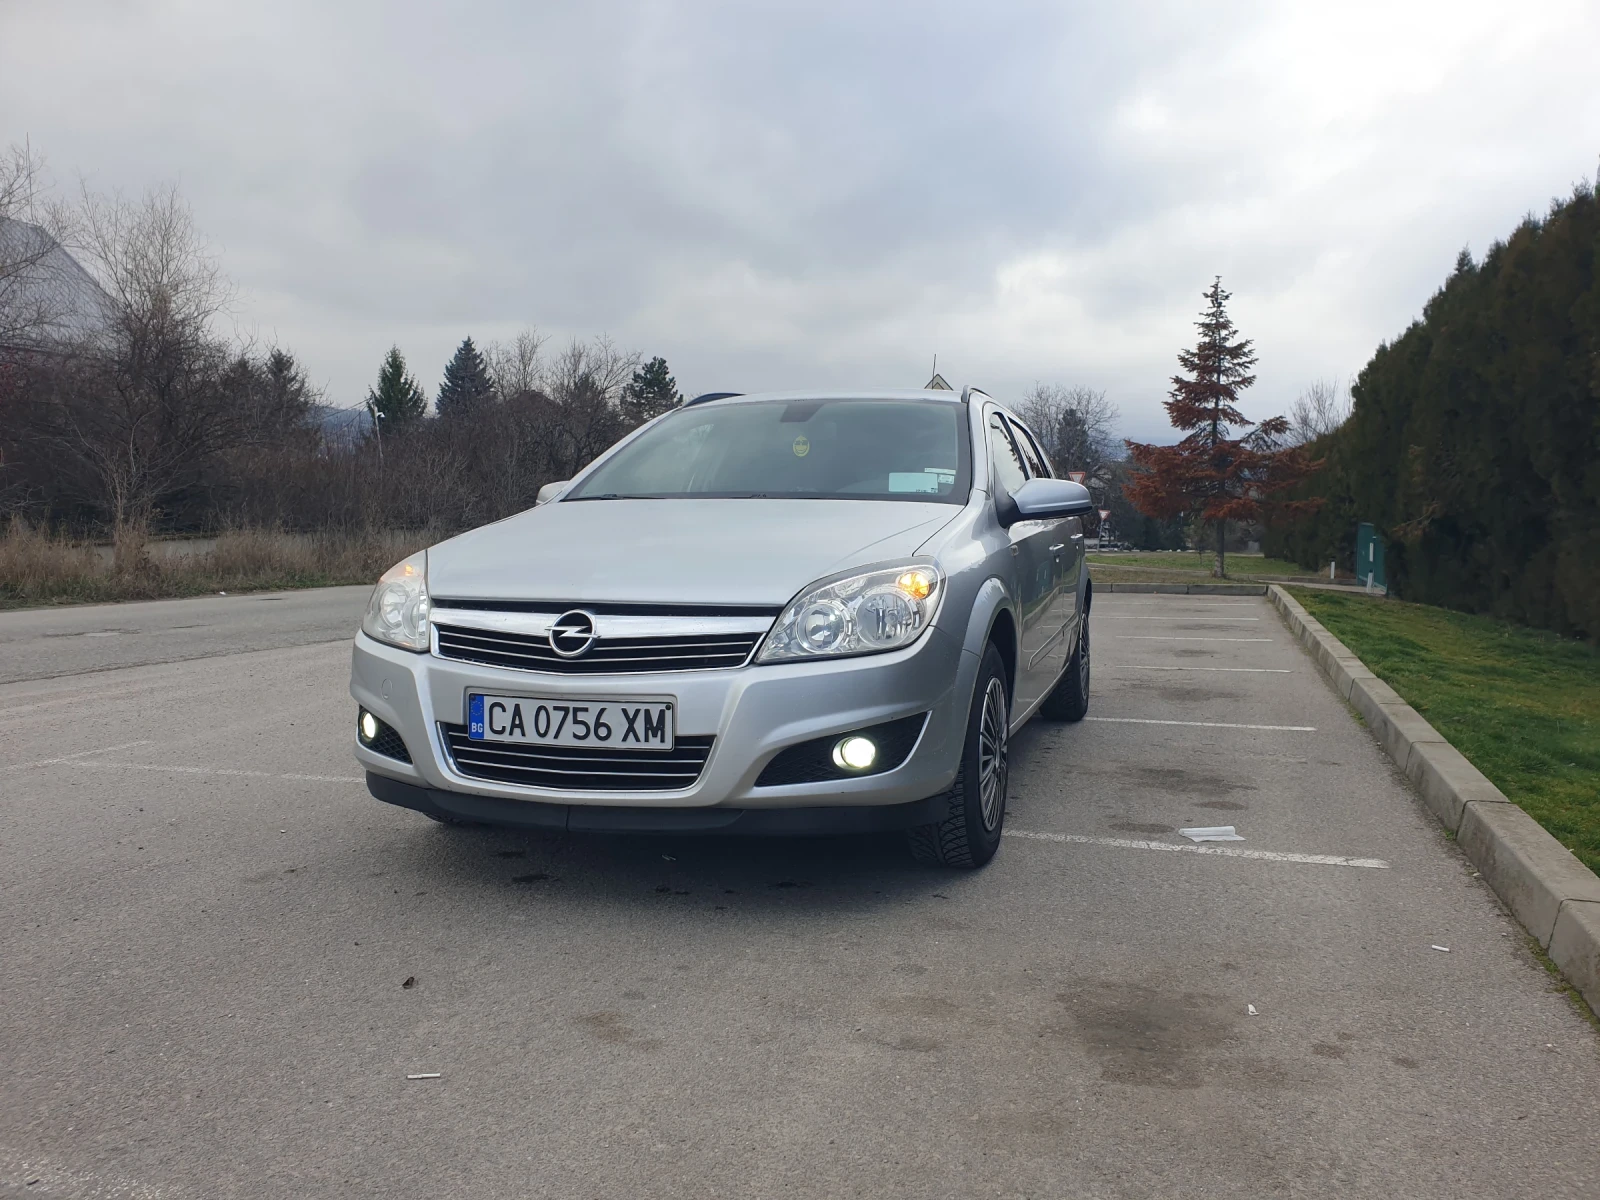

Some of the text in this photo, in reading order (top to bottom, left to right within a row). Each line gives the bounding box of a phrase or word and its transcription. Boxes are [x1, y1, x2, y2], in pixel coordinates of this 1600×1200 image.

[471, 722, 484, 733] BG
[488, 701, 666, 743] CA 0756 XM
